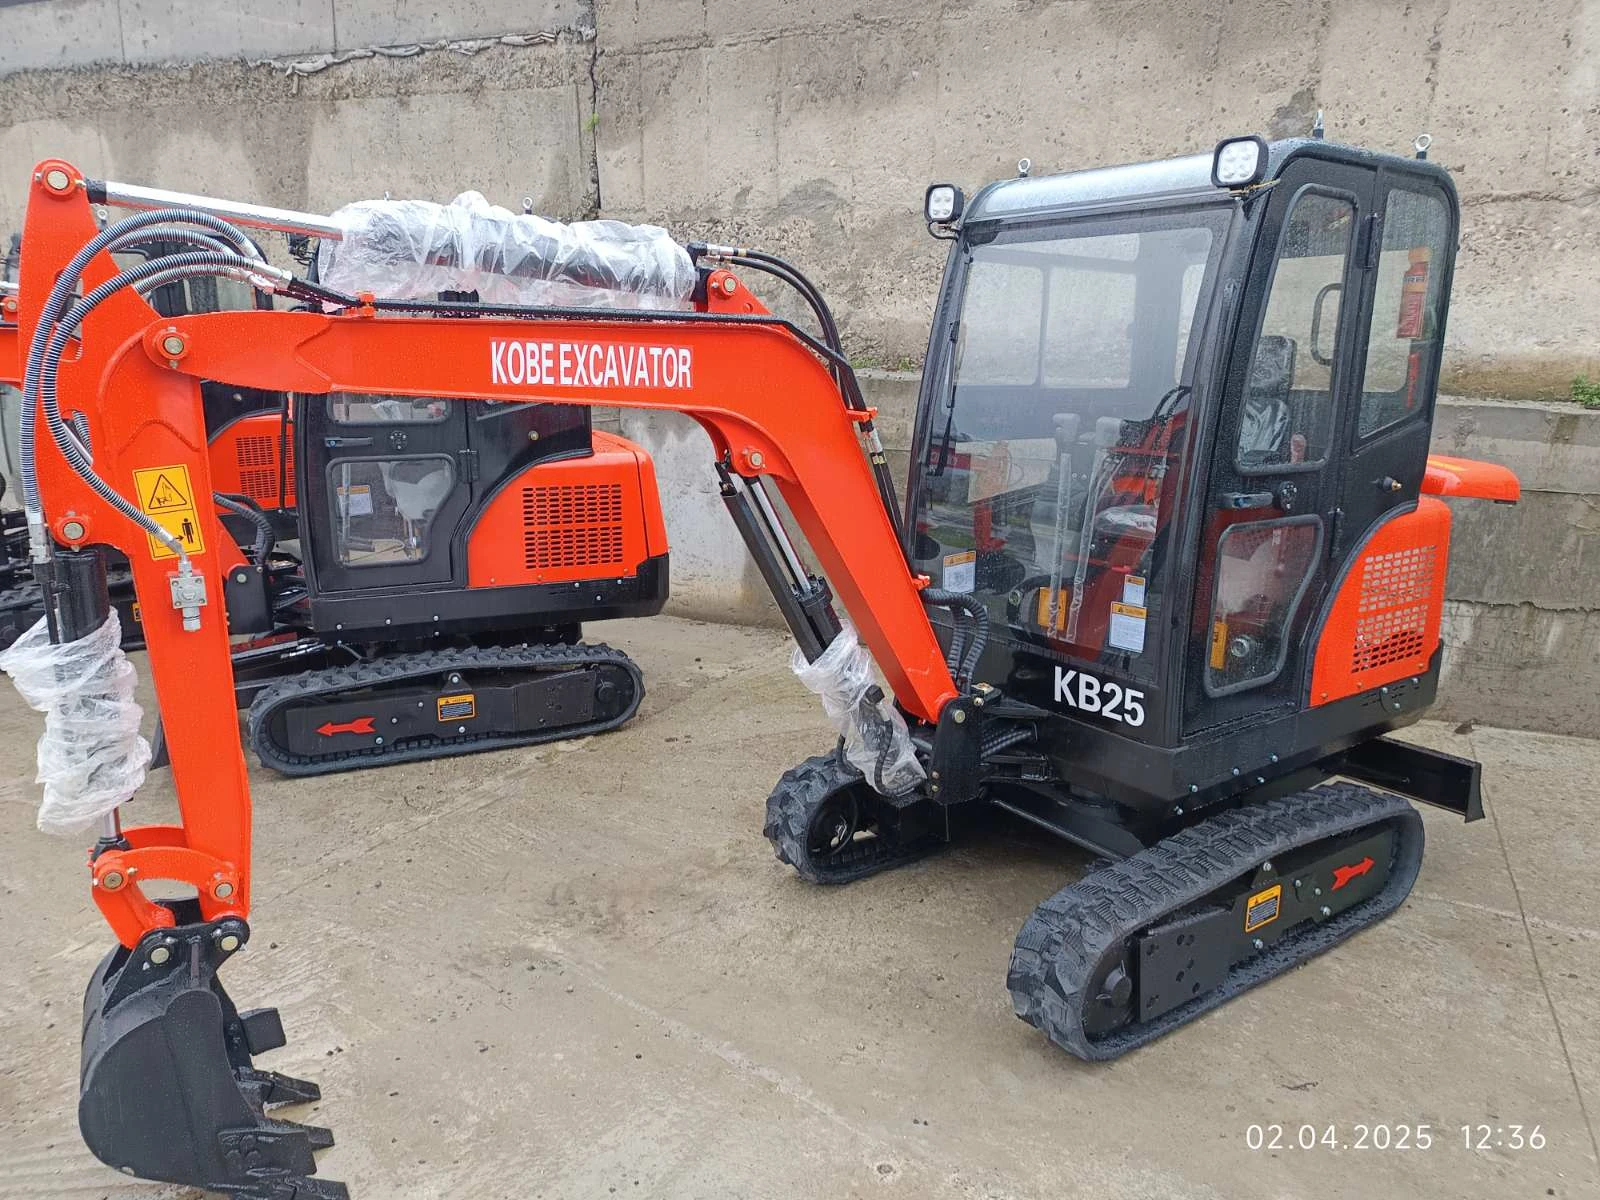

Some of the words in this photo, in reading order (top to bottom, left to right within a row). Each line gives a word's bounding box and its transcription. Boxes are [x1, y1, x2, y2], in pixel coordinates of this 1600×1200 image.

[491, 341, 555, 385] KOBE
[559, 343, 692, 388] EXCAVATOR
[1054, 665, 1145, 727] KB25
